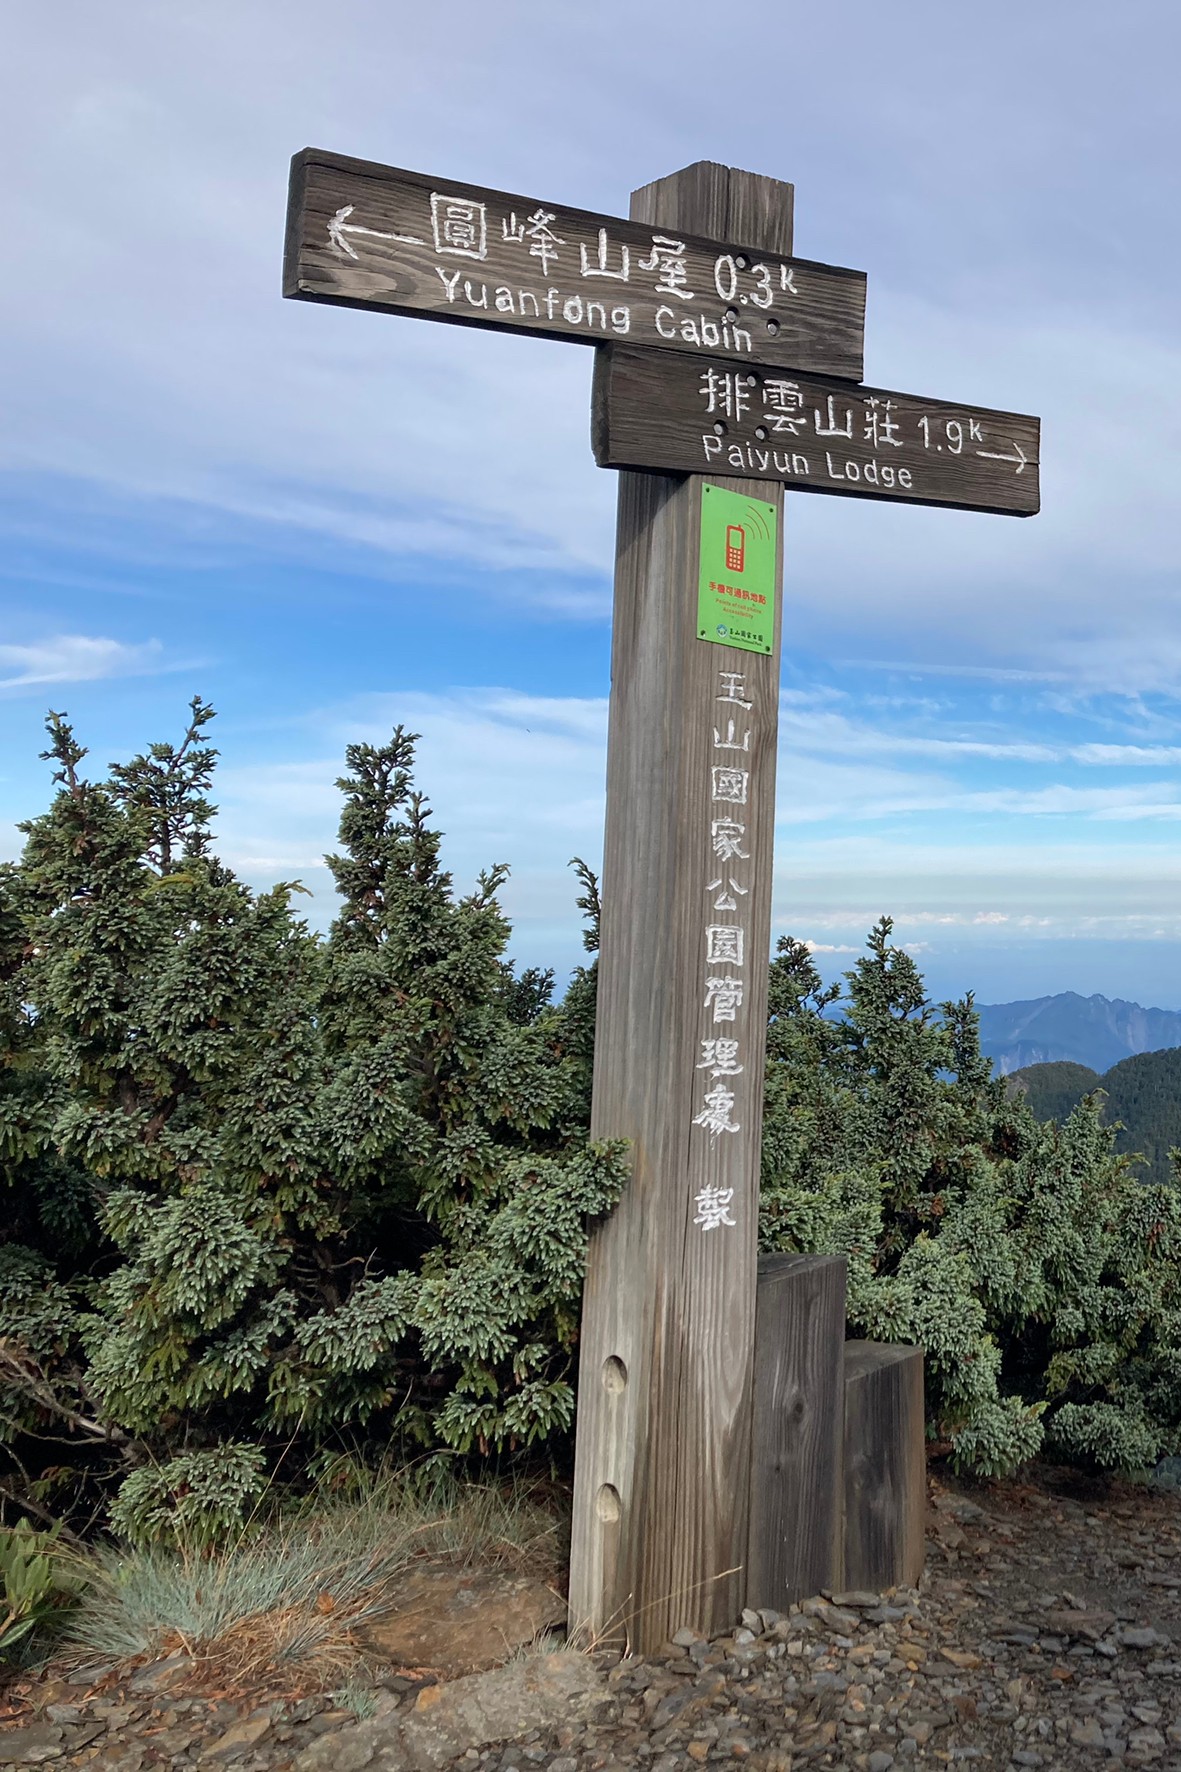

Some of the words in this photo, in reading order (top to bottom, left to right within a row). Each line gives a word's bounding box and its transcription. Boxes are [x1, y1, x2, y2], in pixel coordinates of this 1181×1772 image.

[429, 191, 695, 299] 圓峰山屋
[654, 305, 752, 352] Cabin
[699, 367, 903, 448] 排雲山莊
[701, 434, 809, 475] Paiyun
[825, 451, 913, 489] Lodge
